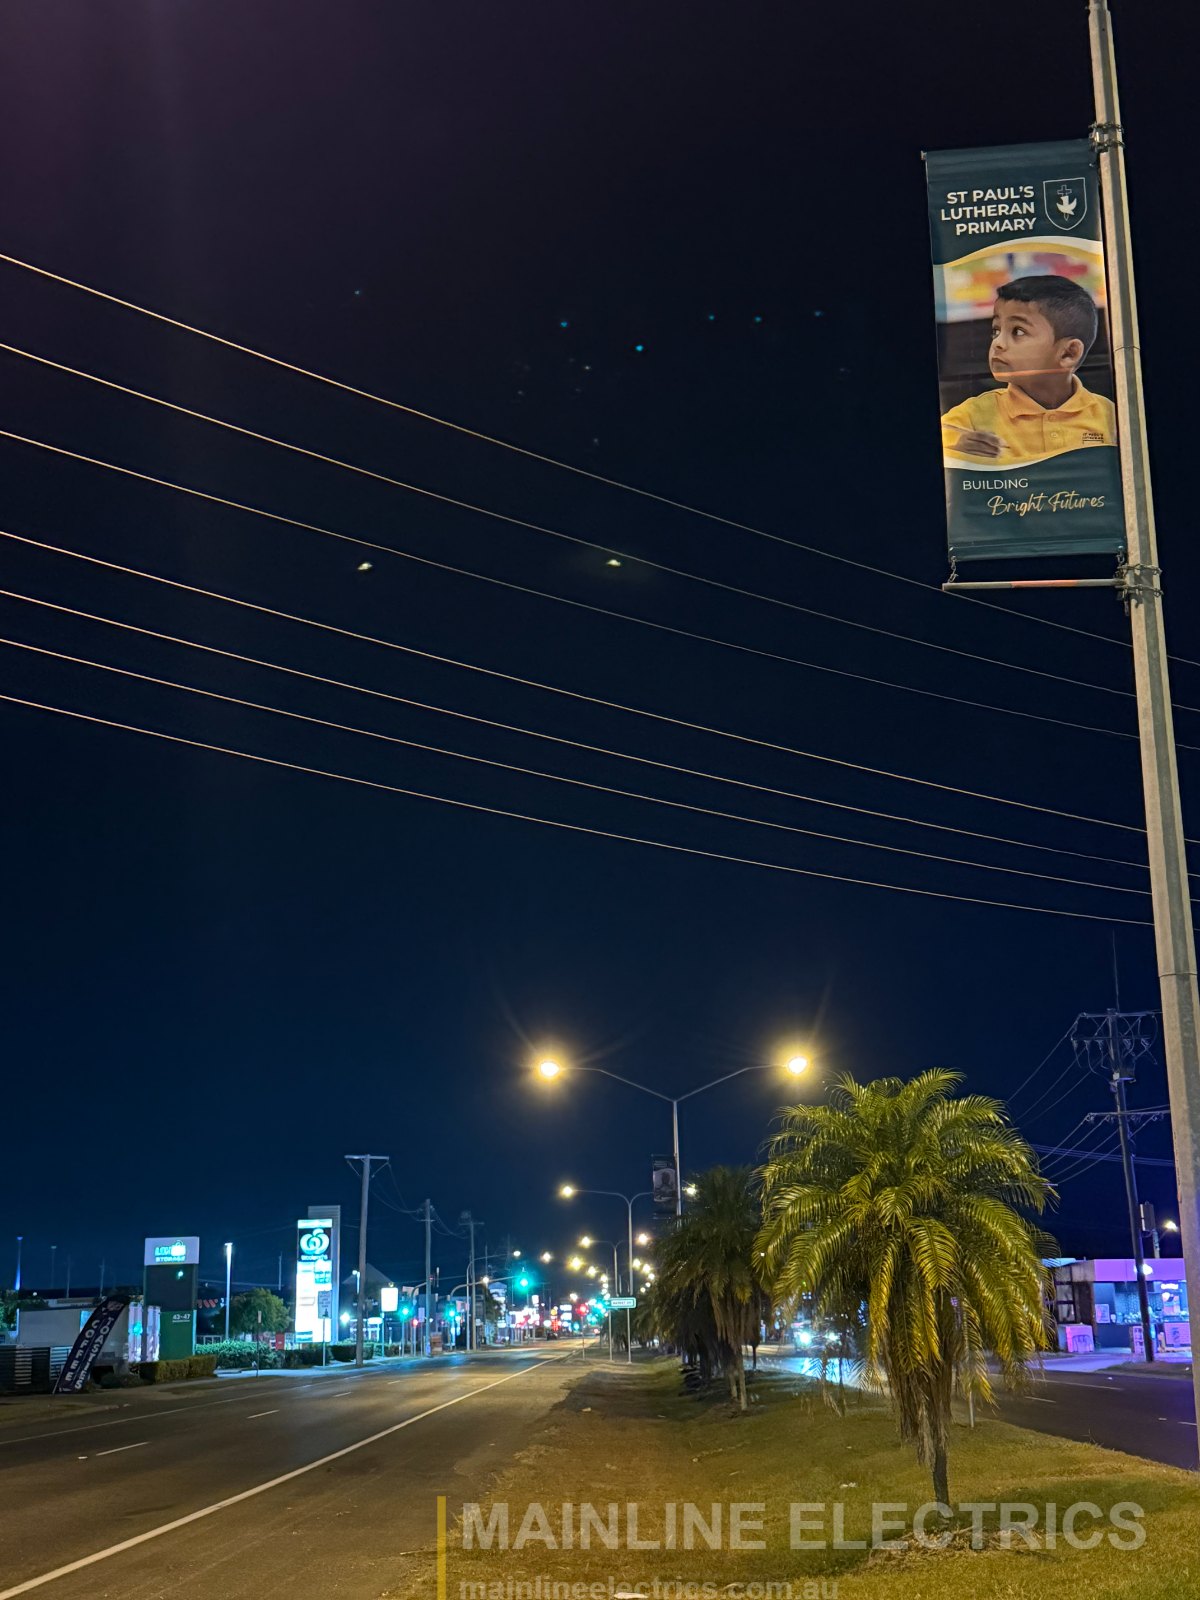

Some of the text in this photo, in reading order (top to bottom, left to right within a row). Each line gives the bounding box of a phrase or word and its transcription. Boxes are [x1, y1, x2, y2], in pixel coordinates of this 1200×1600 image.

[947, 185, 1034, 204] ST PAUL'S
[941, 202, 1035, 221] LUTHERAN
[956, 217, 1037, 236] PRIMARY
[962, 478, 1029, 490] BUILDING
[987, 490, 1105, 517] Bright Futures
[65, 1319, 100, 1381] COFFEE
[74, 1316, 115, 1389] TOASTIES
